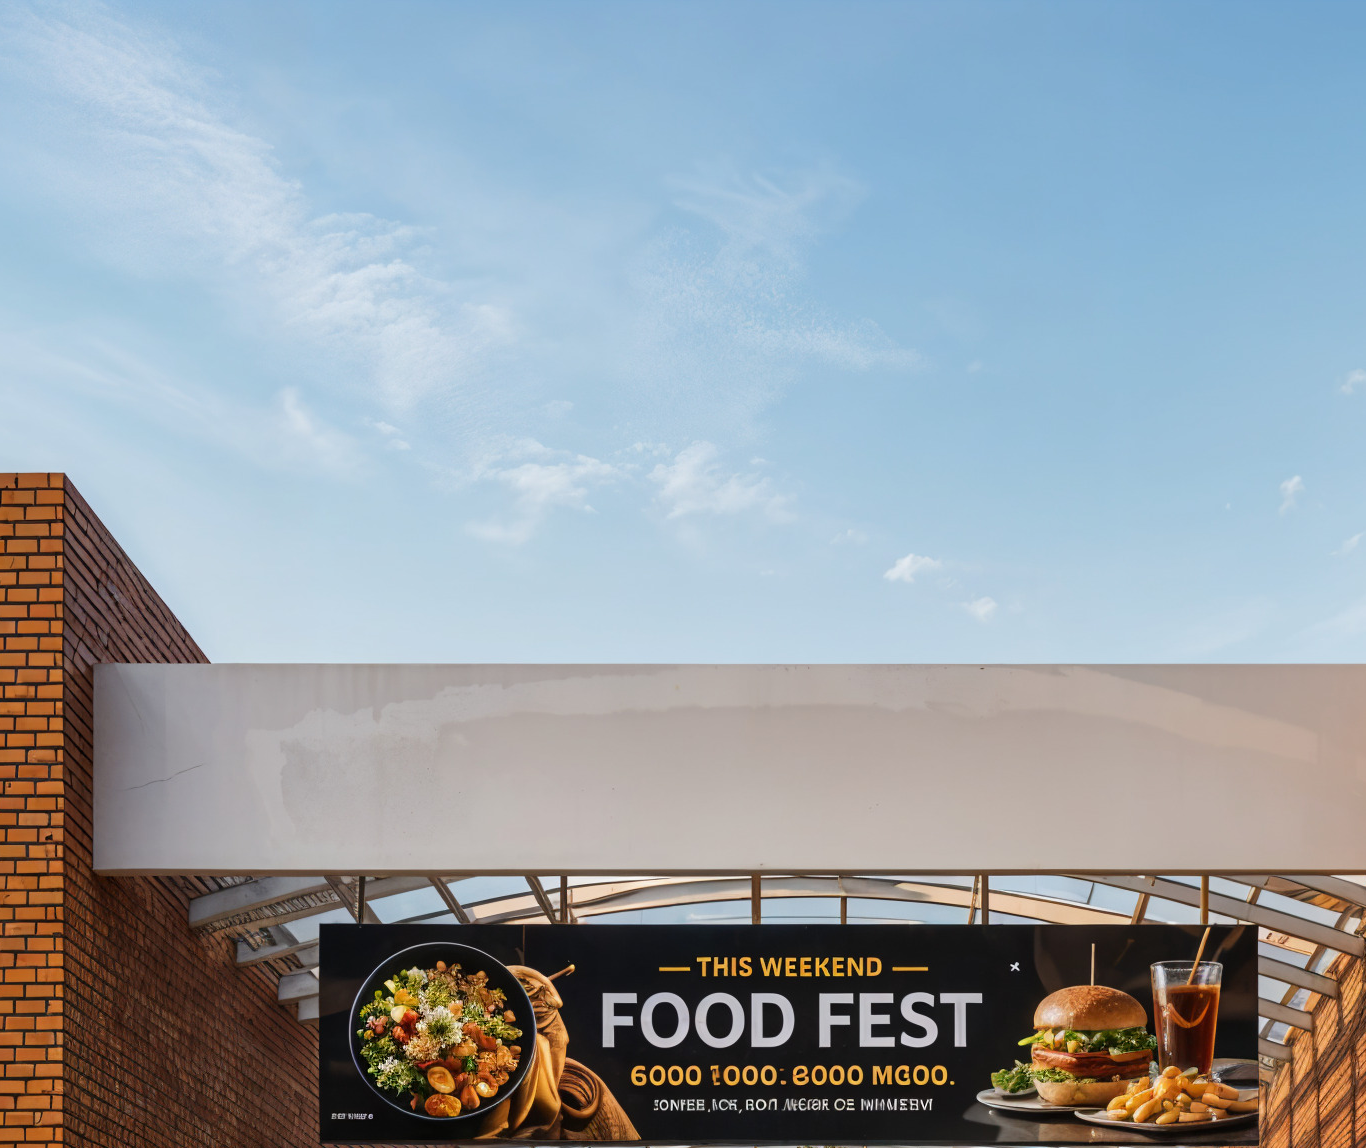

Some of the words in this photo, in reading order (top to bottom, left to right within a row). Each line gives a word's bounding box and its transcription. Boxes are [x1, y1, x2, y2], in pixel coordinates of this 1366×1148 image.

[696, 956, 753, 977] THIS
[759, 956, 883, 977] WEEKEND
[602, 991, 796, 1049] FOOD
[818, 991, 983, 1048] FEST
